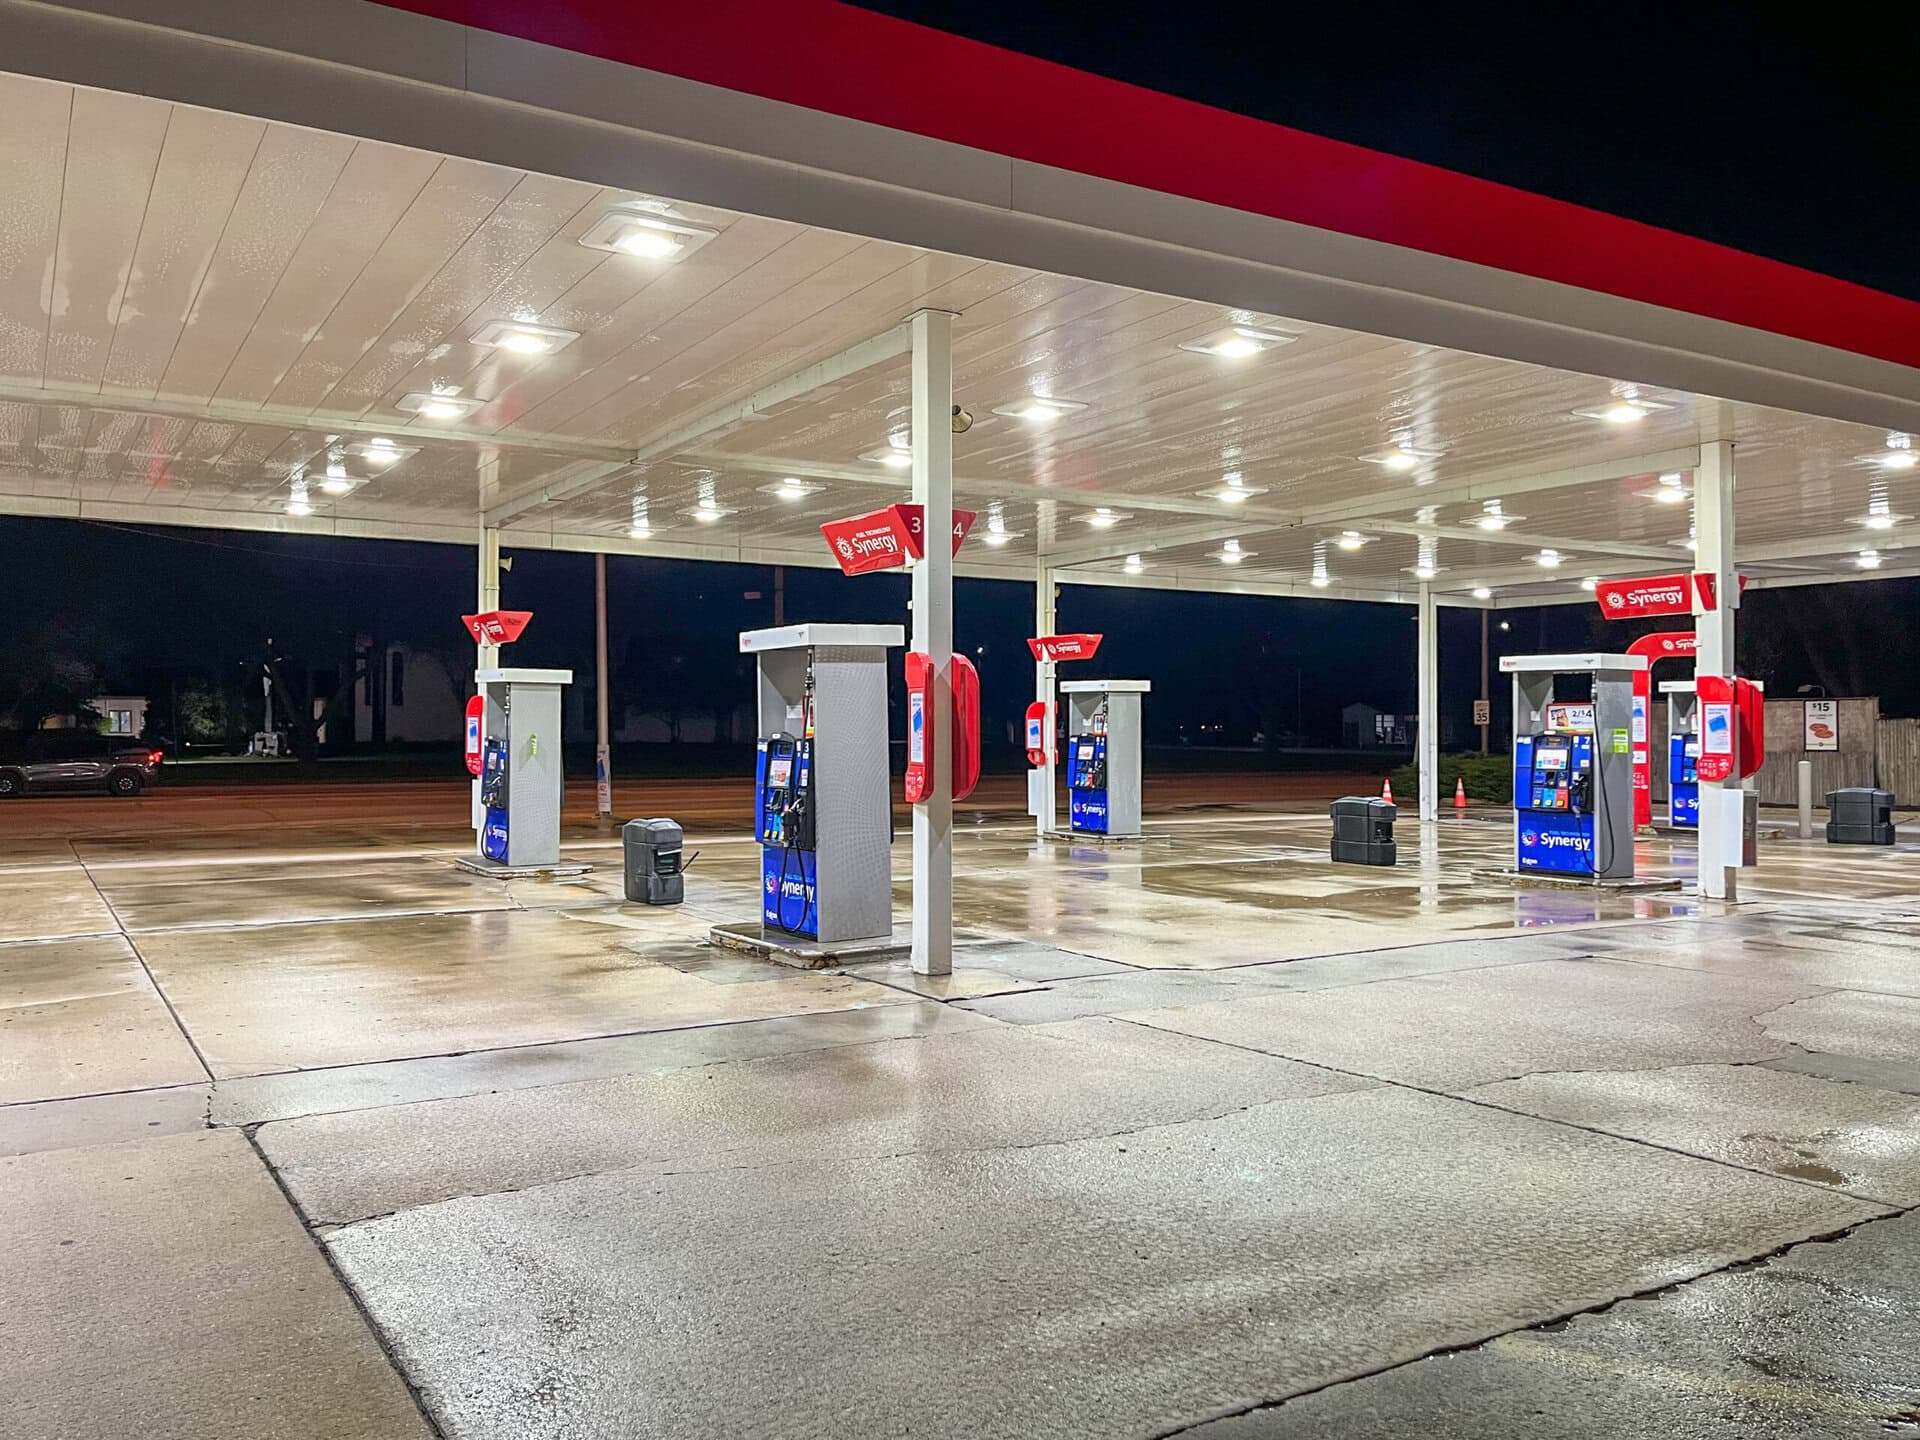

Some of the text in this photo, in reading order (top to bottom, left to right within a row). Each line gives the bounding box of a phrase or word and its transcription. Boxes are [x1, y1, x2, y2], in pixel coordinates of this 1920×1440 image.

[911, 517, 921, 533] 3
[953, 522, 964, 538] 4
[852, 534, 898, 557] Synergy
[1627, 592, 1683, 607] Synergy
[474, 622, 480, 632] 5
[1812, 702, 1830, 711] $15
[1476, 712, 1488, 722] 35
[1572, 709, 1592, 718] 2/$4
[1584, 736, 1591, 745] 7
[804, 742, 809, 752] 3
[1540, 832, 1591, 851] Synergy
